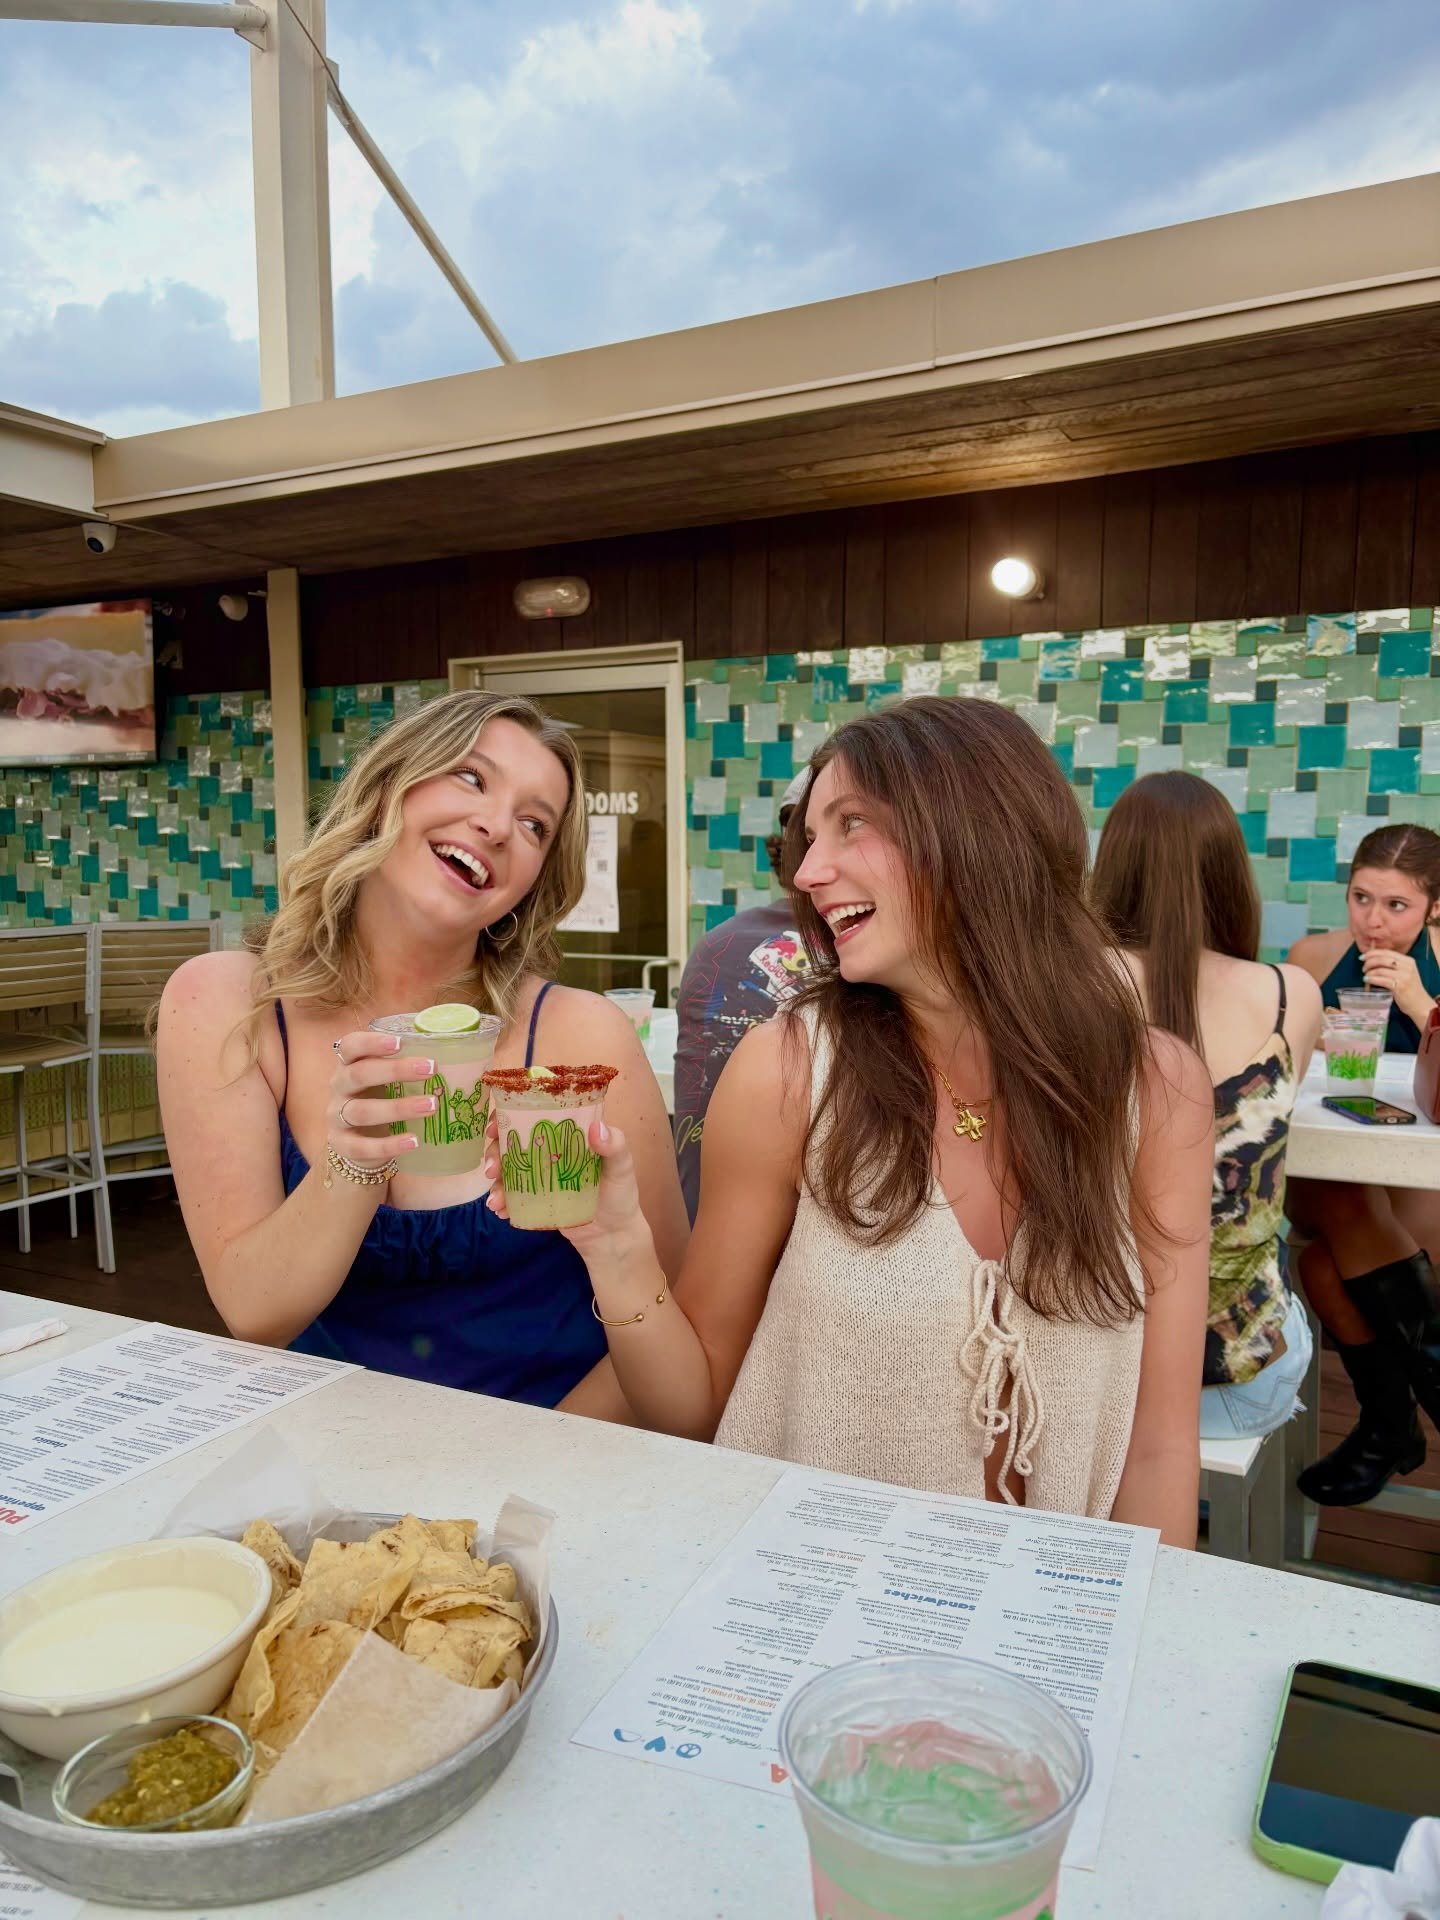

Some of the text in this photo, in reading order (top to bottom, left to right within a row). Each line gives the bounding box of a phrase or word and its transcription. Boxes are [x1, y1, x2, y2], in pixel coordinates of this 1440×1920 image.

[0, 1507, 30, 1525] PU
[1035, 1568, 1124, 1587] specialties
[883, 1589, 977, 1611] sandwiches
